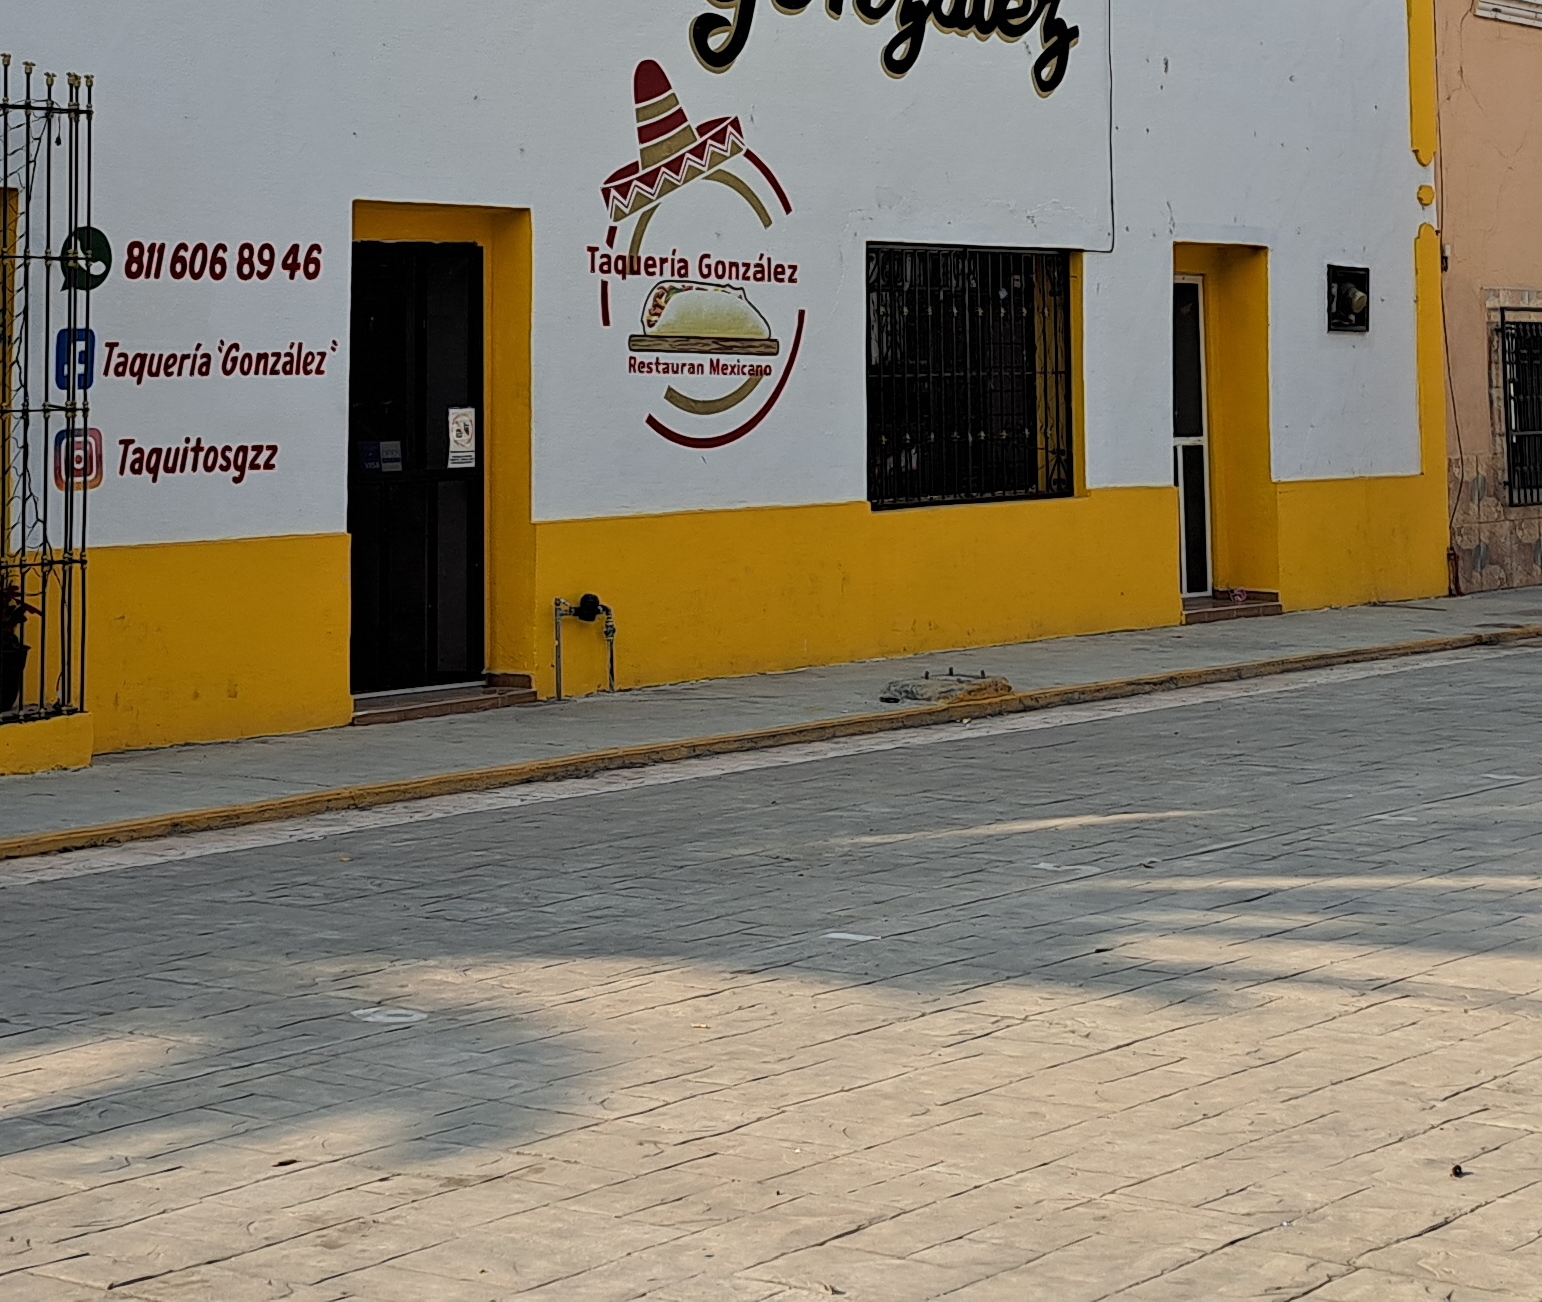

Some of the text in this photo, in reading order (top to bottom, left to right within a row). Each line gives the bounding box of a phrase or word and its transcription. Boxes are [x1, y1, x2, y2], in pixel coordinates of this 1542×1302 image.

[124, 240, 323, 281] 811 606 89 46
[587, 245, 799, 284] Taquería González
[102, 341, 212, 385] Taquería
[628, 356, 772, 377] Restauran Mexicano
[118, 436, 279, 485] Taquitosgzz
